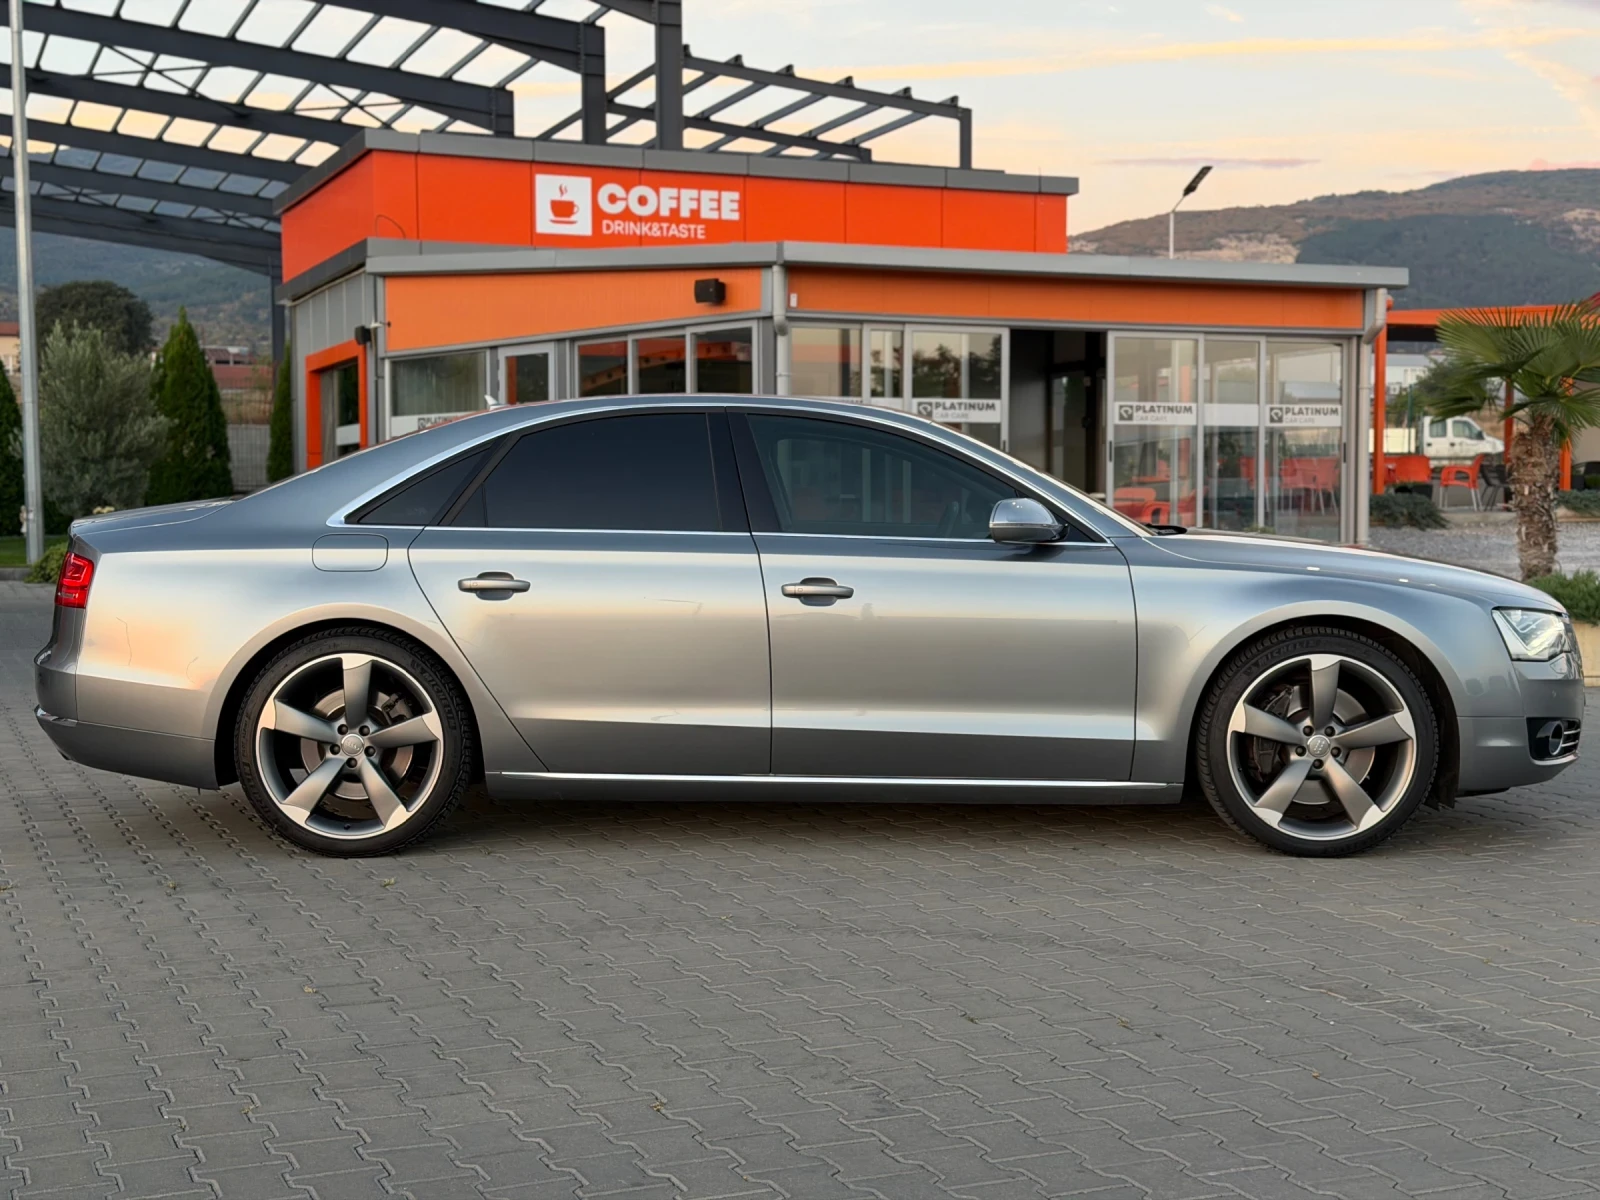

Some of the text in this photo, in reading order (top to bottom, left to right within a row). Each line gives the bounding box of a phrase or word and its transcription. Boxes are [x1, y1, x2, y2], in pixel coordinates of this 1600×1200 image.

[597, 183, 740, 221] COFFEE
[602, 219, 706, 239] DRINK&TASTE
[934, 401, 996, 411] PLATINUM
[1135, 404, 1193, 414] PLATINUM
[1284, 406, 1339, 416] PLATINUM
[422, 672, 457, 729] MICHELIN
